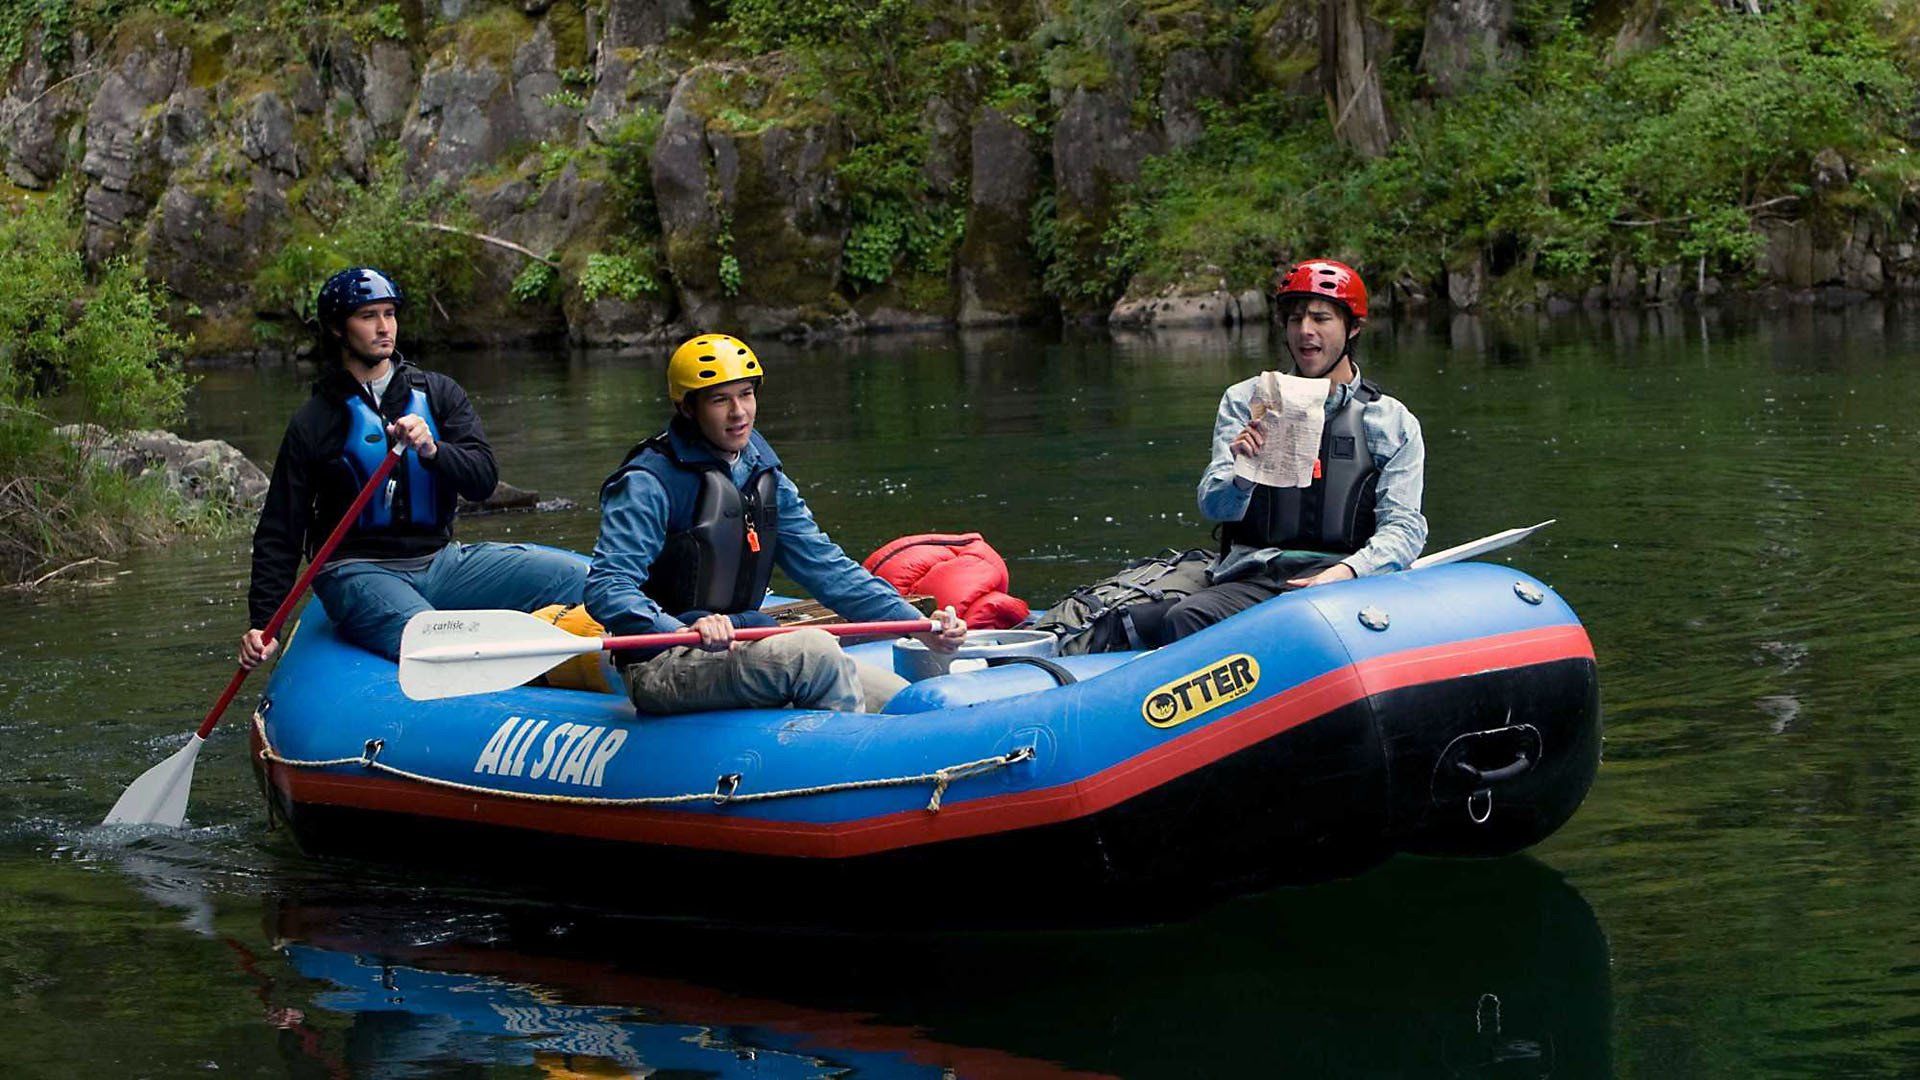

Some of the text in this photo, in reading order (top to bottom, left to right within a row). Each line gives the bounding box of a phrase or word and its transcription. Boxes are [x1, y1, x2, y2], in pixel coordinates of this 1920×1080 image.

[1146, 657, 1255, 723] OTTER
[474, 716, 629, 787] ALL STAR
